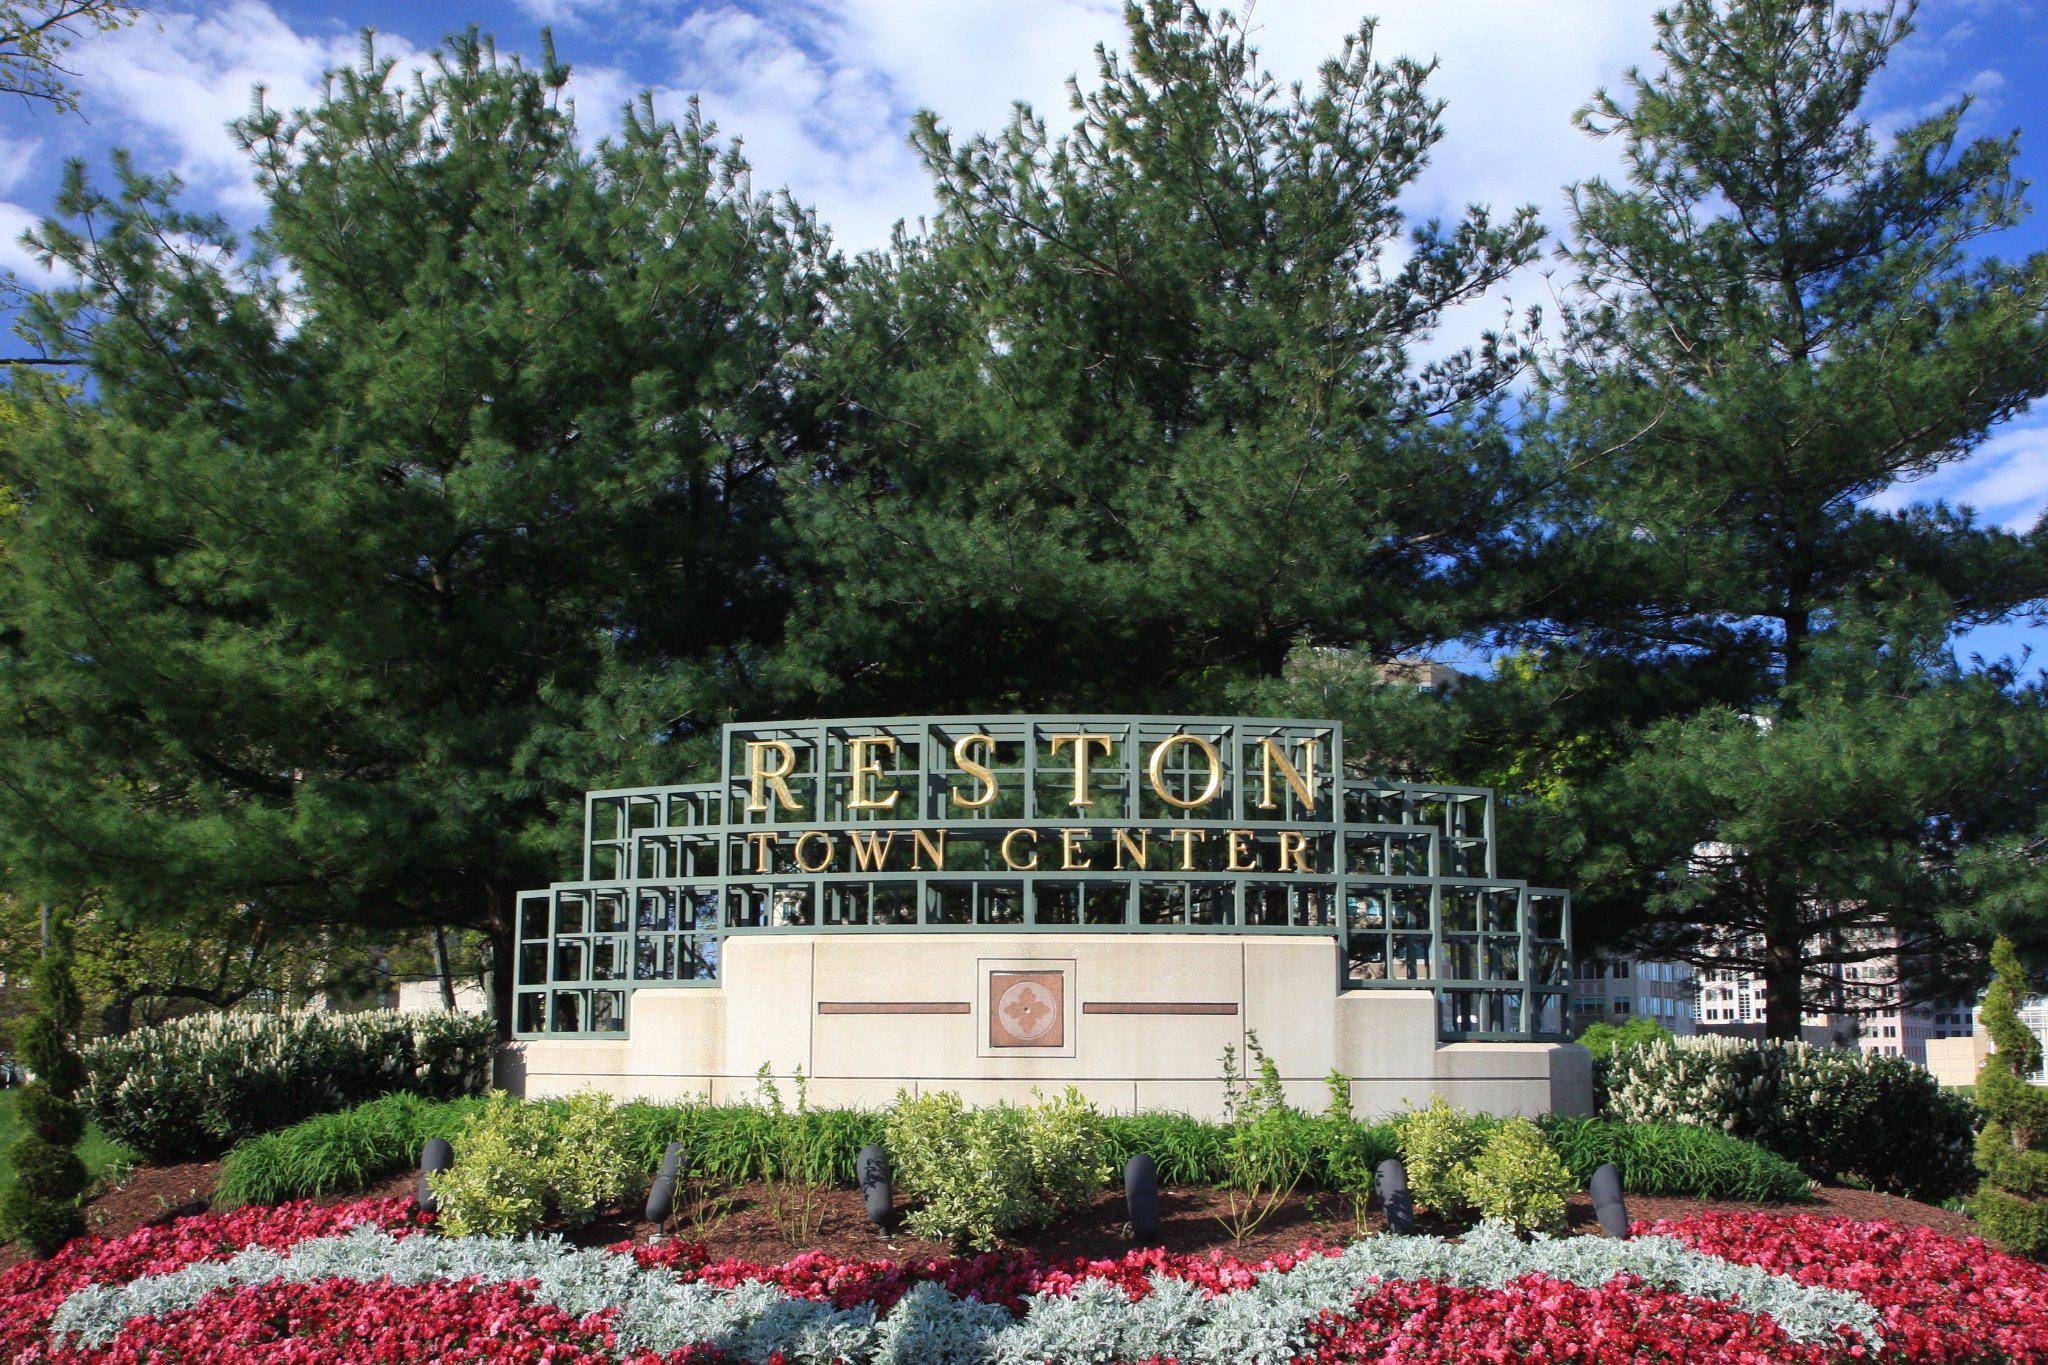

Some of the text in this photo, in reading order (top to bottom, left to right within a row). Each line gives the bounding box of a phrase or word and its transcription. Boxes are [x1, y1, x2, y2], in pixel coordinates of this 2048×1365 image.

[747, 734, 1318, 811] RESTON
[748, 828, 1314, 873] TOWN CENTER
